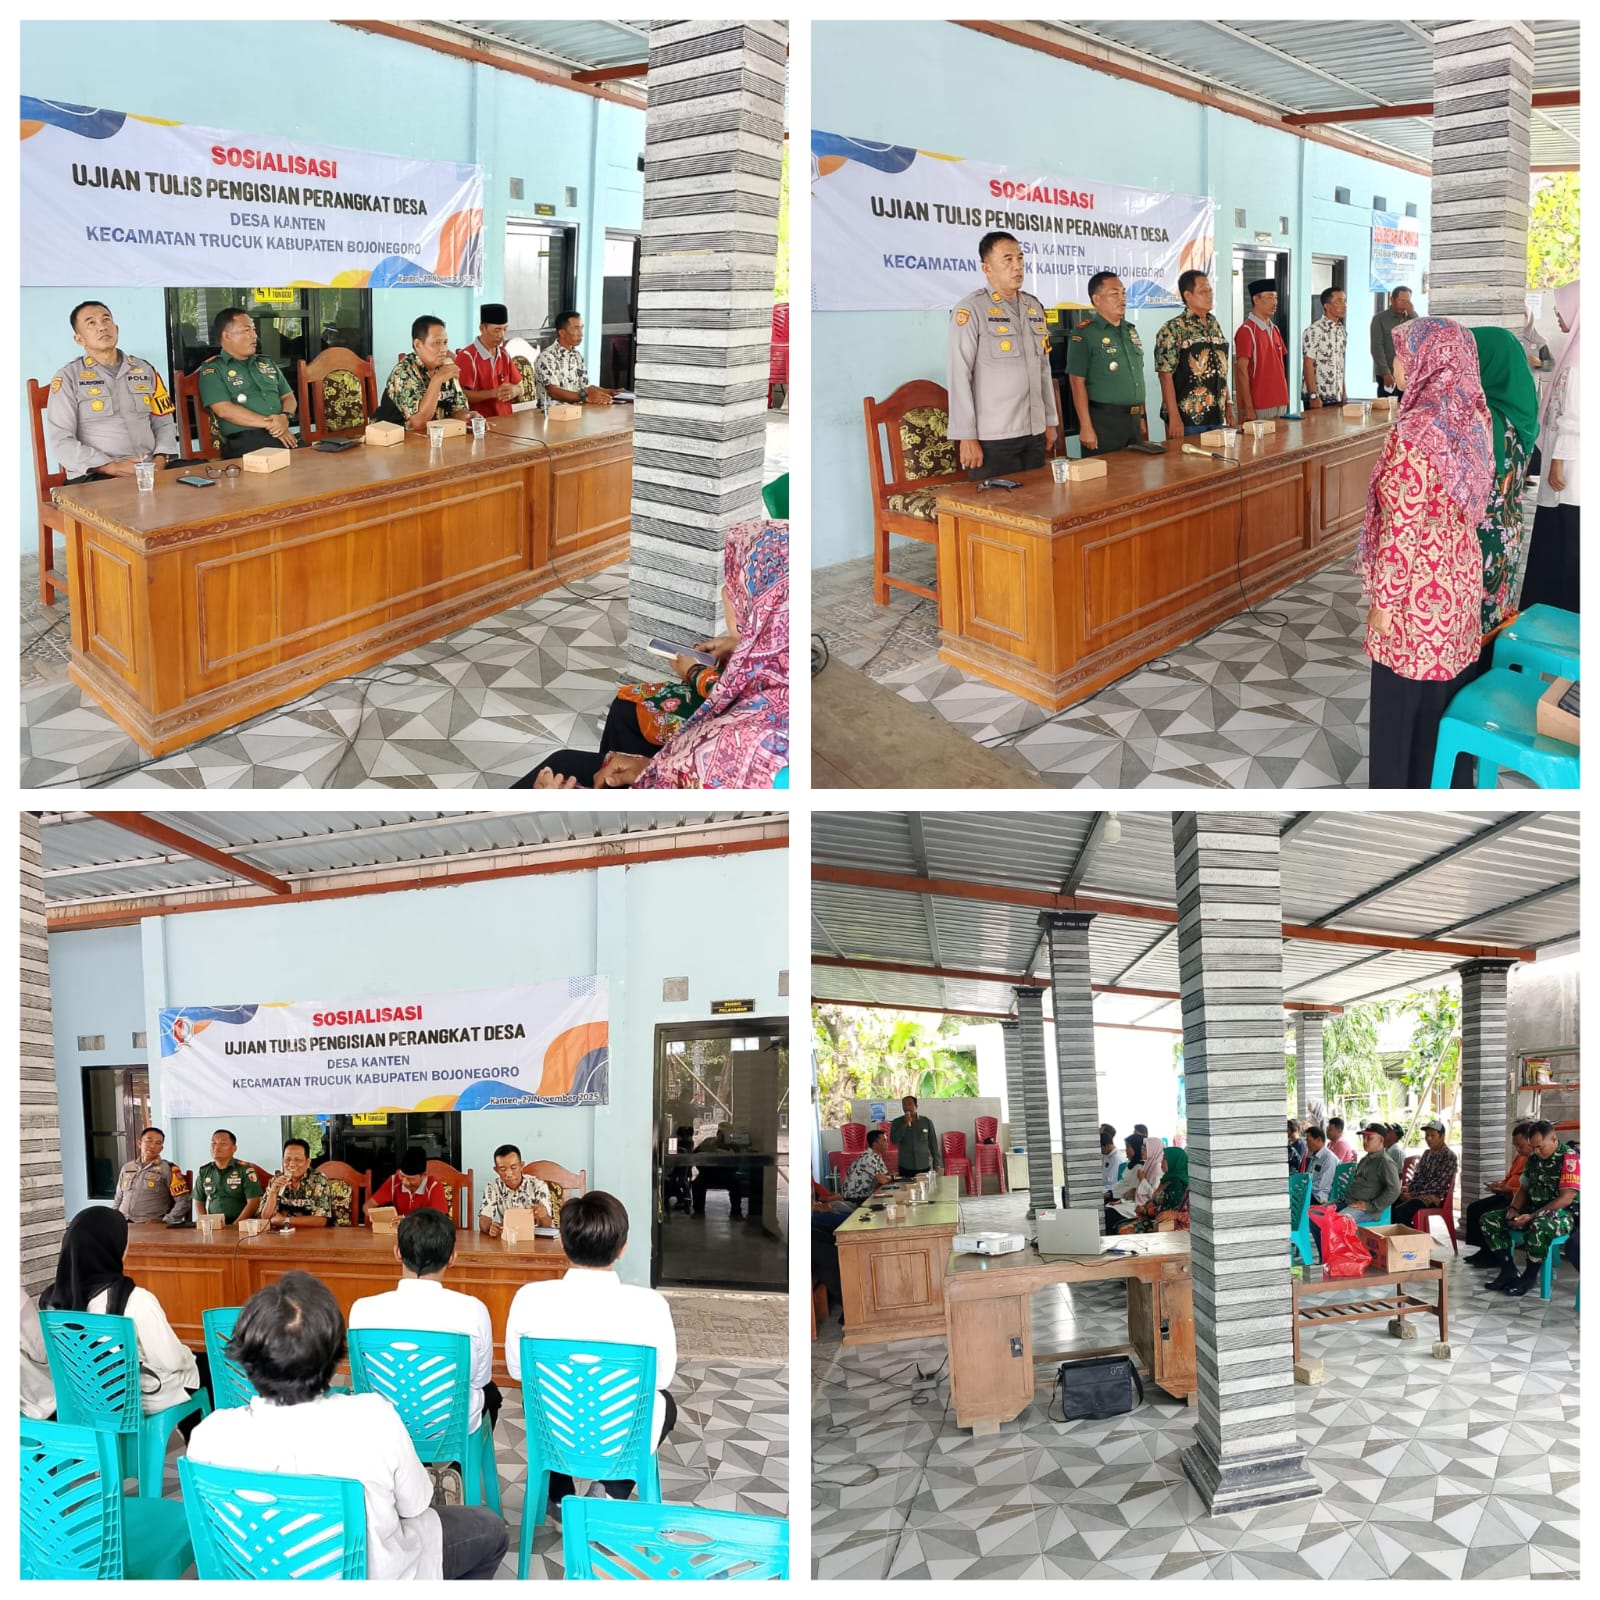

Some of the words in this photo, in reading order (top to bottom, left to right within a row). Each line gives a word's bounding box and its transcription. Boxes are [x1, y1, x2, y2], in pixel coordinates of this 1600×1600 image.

[211, 145, 337, 179] SOSIALISASI
[72, 163, 141, 191] UJIAN
[145, 172, 201, 197] TULIS
[206, 178, 300, 206] PENGISIAN
[303, 188, 391, 213] PERANGKAT
[393, 197, 427, 216] DESA
[989, 179, 1094, 209] SOSIALISASI
[230, 212, 270, 227] DESA
[274, 215, 325, 231] KANTEN
[870, 196, 929, 222] UJIAN
[933, 204, 982, 227] TULIS
[985, 209, 1063, 234] PENGISIAN
[1066, 218, 1138, 240] PERANGKAT
[1141, 226, 1169, 243] DESA
[86, 225, 195, 246] KECAMATAN
[199, 233, 263, 249] TRUCUK
[267, 236, 343, 252] KABUPATEN
[347, 240, 421, 255] BOJONEGORO
[1018, 241, 1039, 254] ESA
[1042, 244, 1085, 257] KANTEN
[883, 254, 977, 273] KECAMATAN
[1036, 262, 1099, 276] KABUPATEN
[312, 1005, 422, 1027] SOSIALISASI
[225, 1039, 267, 1055] UJIAN
[269, 1037, 307, 1054] TULIS
[310, 1032, 385, 1052] PENGISIAN
[389, 1026, 481, 1047] PERANGKAT
[484, 1023, 526, 1042] DESA
[327, 1057, 358, 1069] DESA
[361, 1055, 410, 1068] KANTEN
[232, 1076, 301, 1089] KECAMATAN
[304, 1074, 351, 1087] TRUCUK
[355, 1071, 428, 1084] KABUPATEN
[431, 1066, 520, 1081] BOJONEGORO
[490, 1096, 520, 1105] Kanten,
[533, 1094, 577, 1103] November
[579, 1093, 600, 1101] 2025
